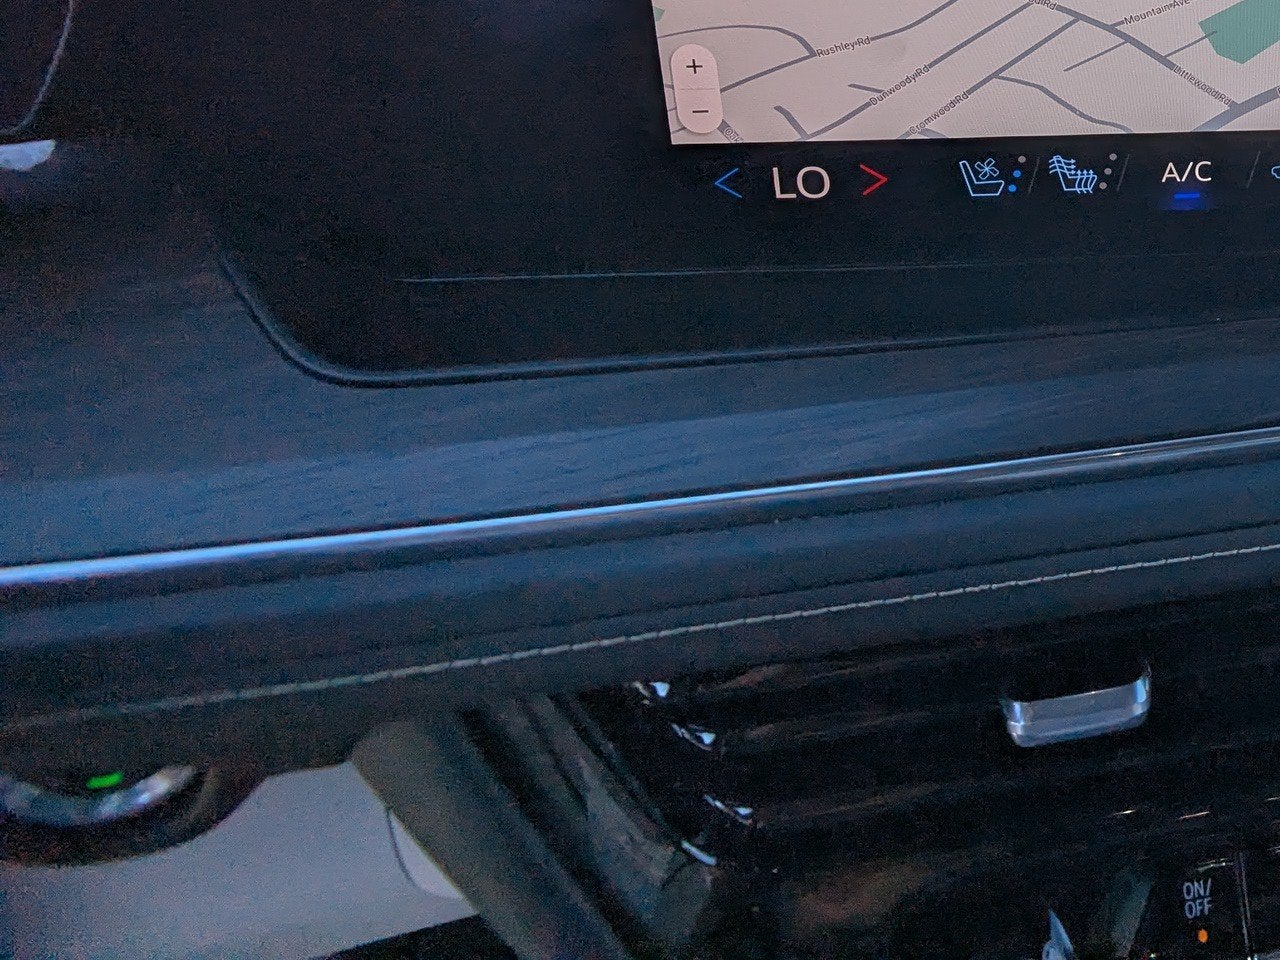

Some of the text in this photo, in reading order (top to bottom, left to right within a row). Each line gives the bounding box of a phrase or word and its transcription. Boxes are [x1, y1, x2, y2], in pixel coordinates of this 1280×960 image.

[1044, 0, 1057, 11] Rd
[1124, 3, 1170, 25] Mountain
[816, 36, 871, 58] Rushley Rd
[869, 64, 930, 106] Dunwoody Rd
[1174, 65, 1231, 106] Littlewood Rd
[909, 92, 969, 134] Cromwood Rd
[773, 167, 830, 199] LO
[1162, 161, 1211, 183] A/C
[1183, 878, 1212, 900] ON/
[1184, 897, 1212, 919] OFF
